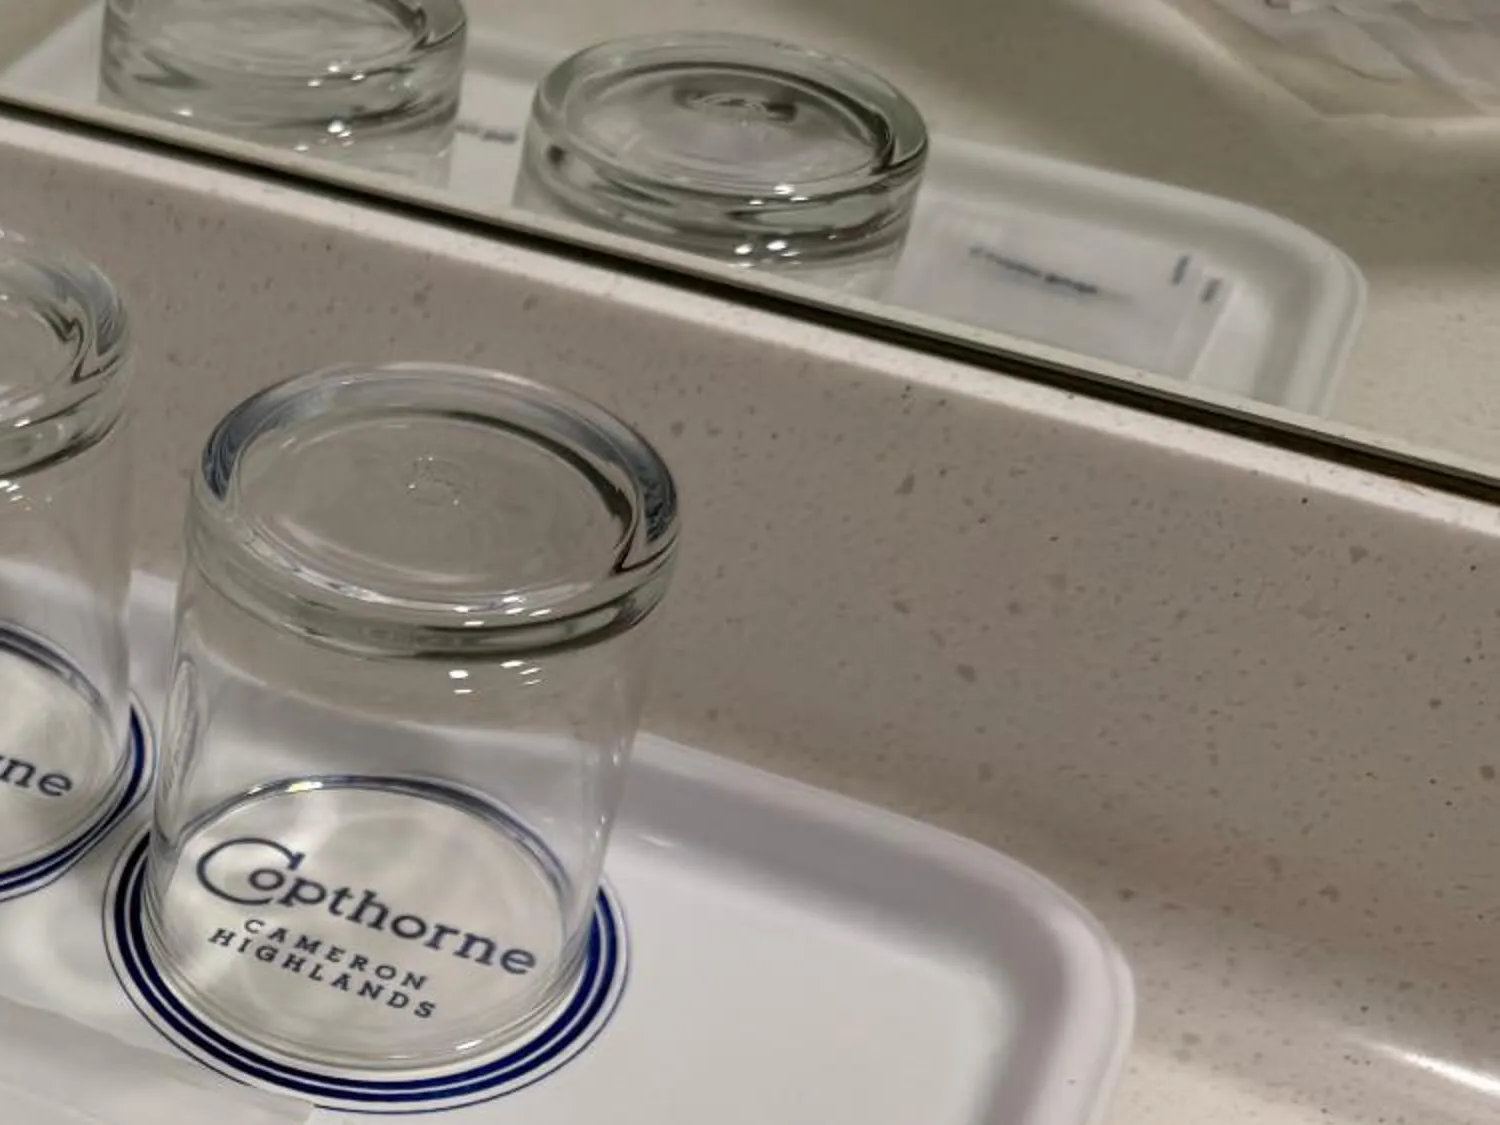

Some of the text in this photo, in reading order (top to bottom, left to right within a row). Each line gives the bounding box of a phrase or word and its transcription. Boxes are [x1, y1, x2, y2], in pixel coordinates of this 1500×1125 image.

[195, 836, 537, 976] Copthorne
[207, 927, 436, 1020] HIGHLANDS
[244, 918, 429, 990] CAMERON
